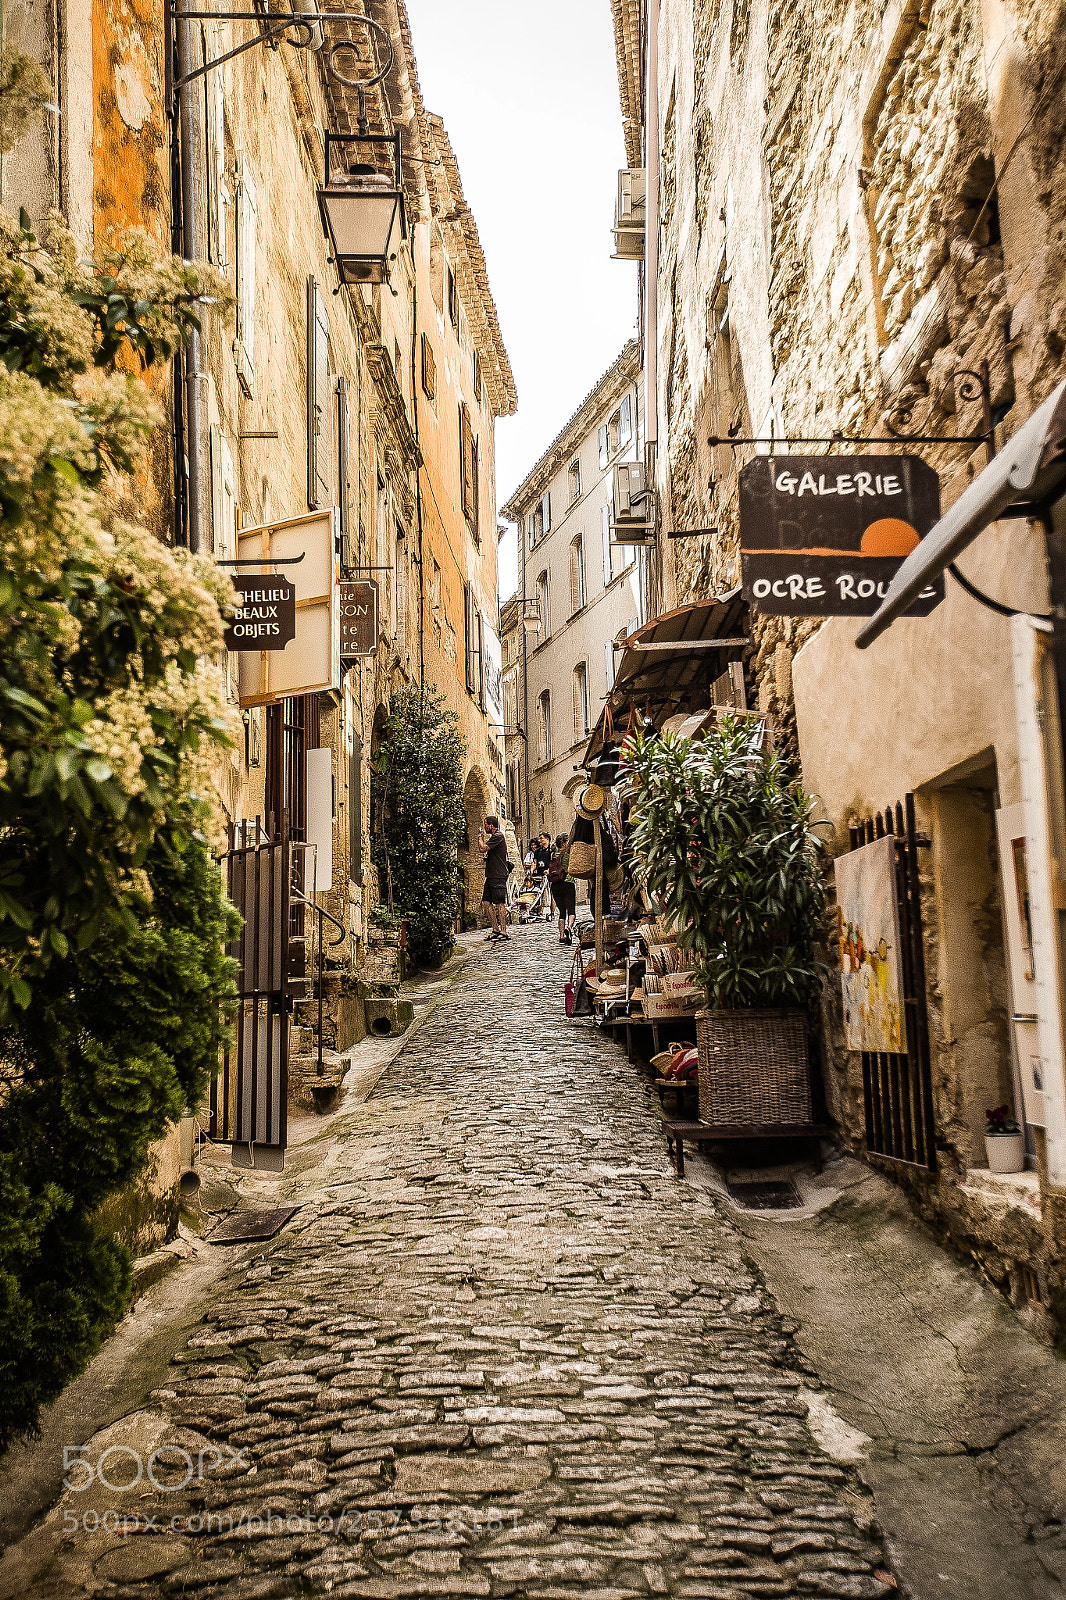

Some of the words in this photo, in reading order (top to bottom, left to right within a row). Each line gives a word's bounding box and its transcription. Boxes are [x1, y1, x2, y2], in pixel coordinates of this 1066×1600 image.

[775, 471, 903, 498] GALERIE
[753, 574, 827, 600] OCRE
[836, 574, 937, 600] ROU
[235, 605, 278, 620] BEAUX
[233, 622, 280, 639] OBJETS
